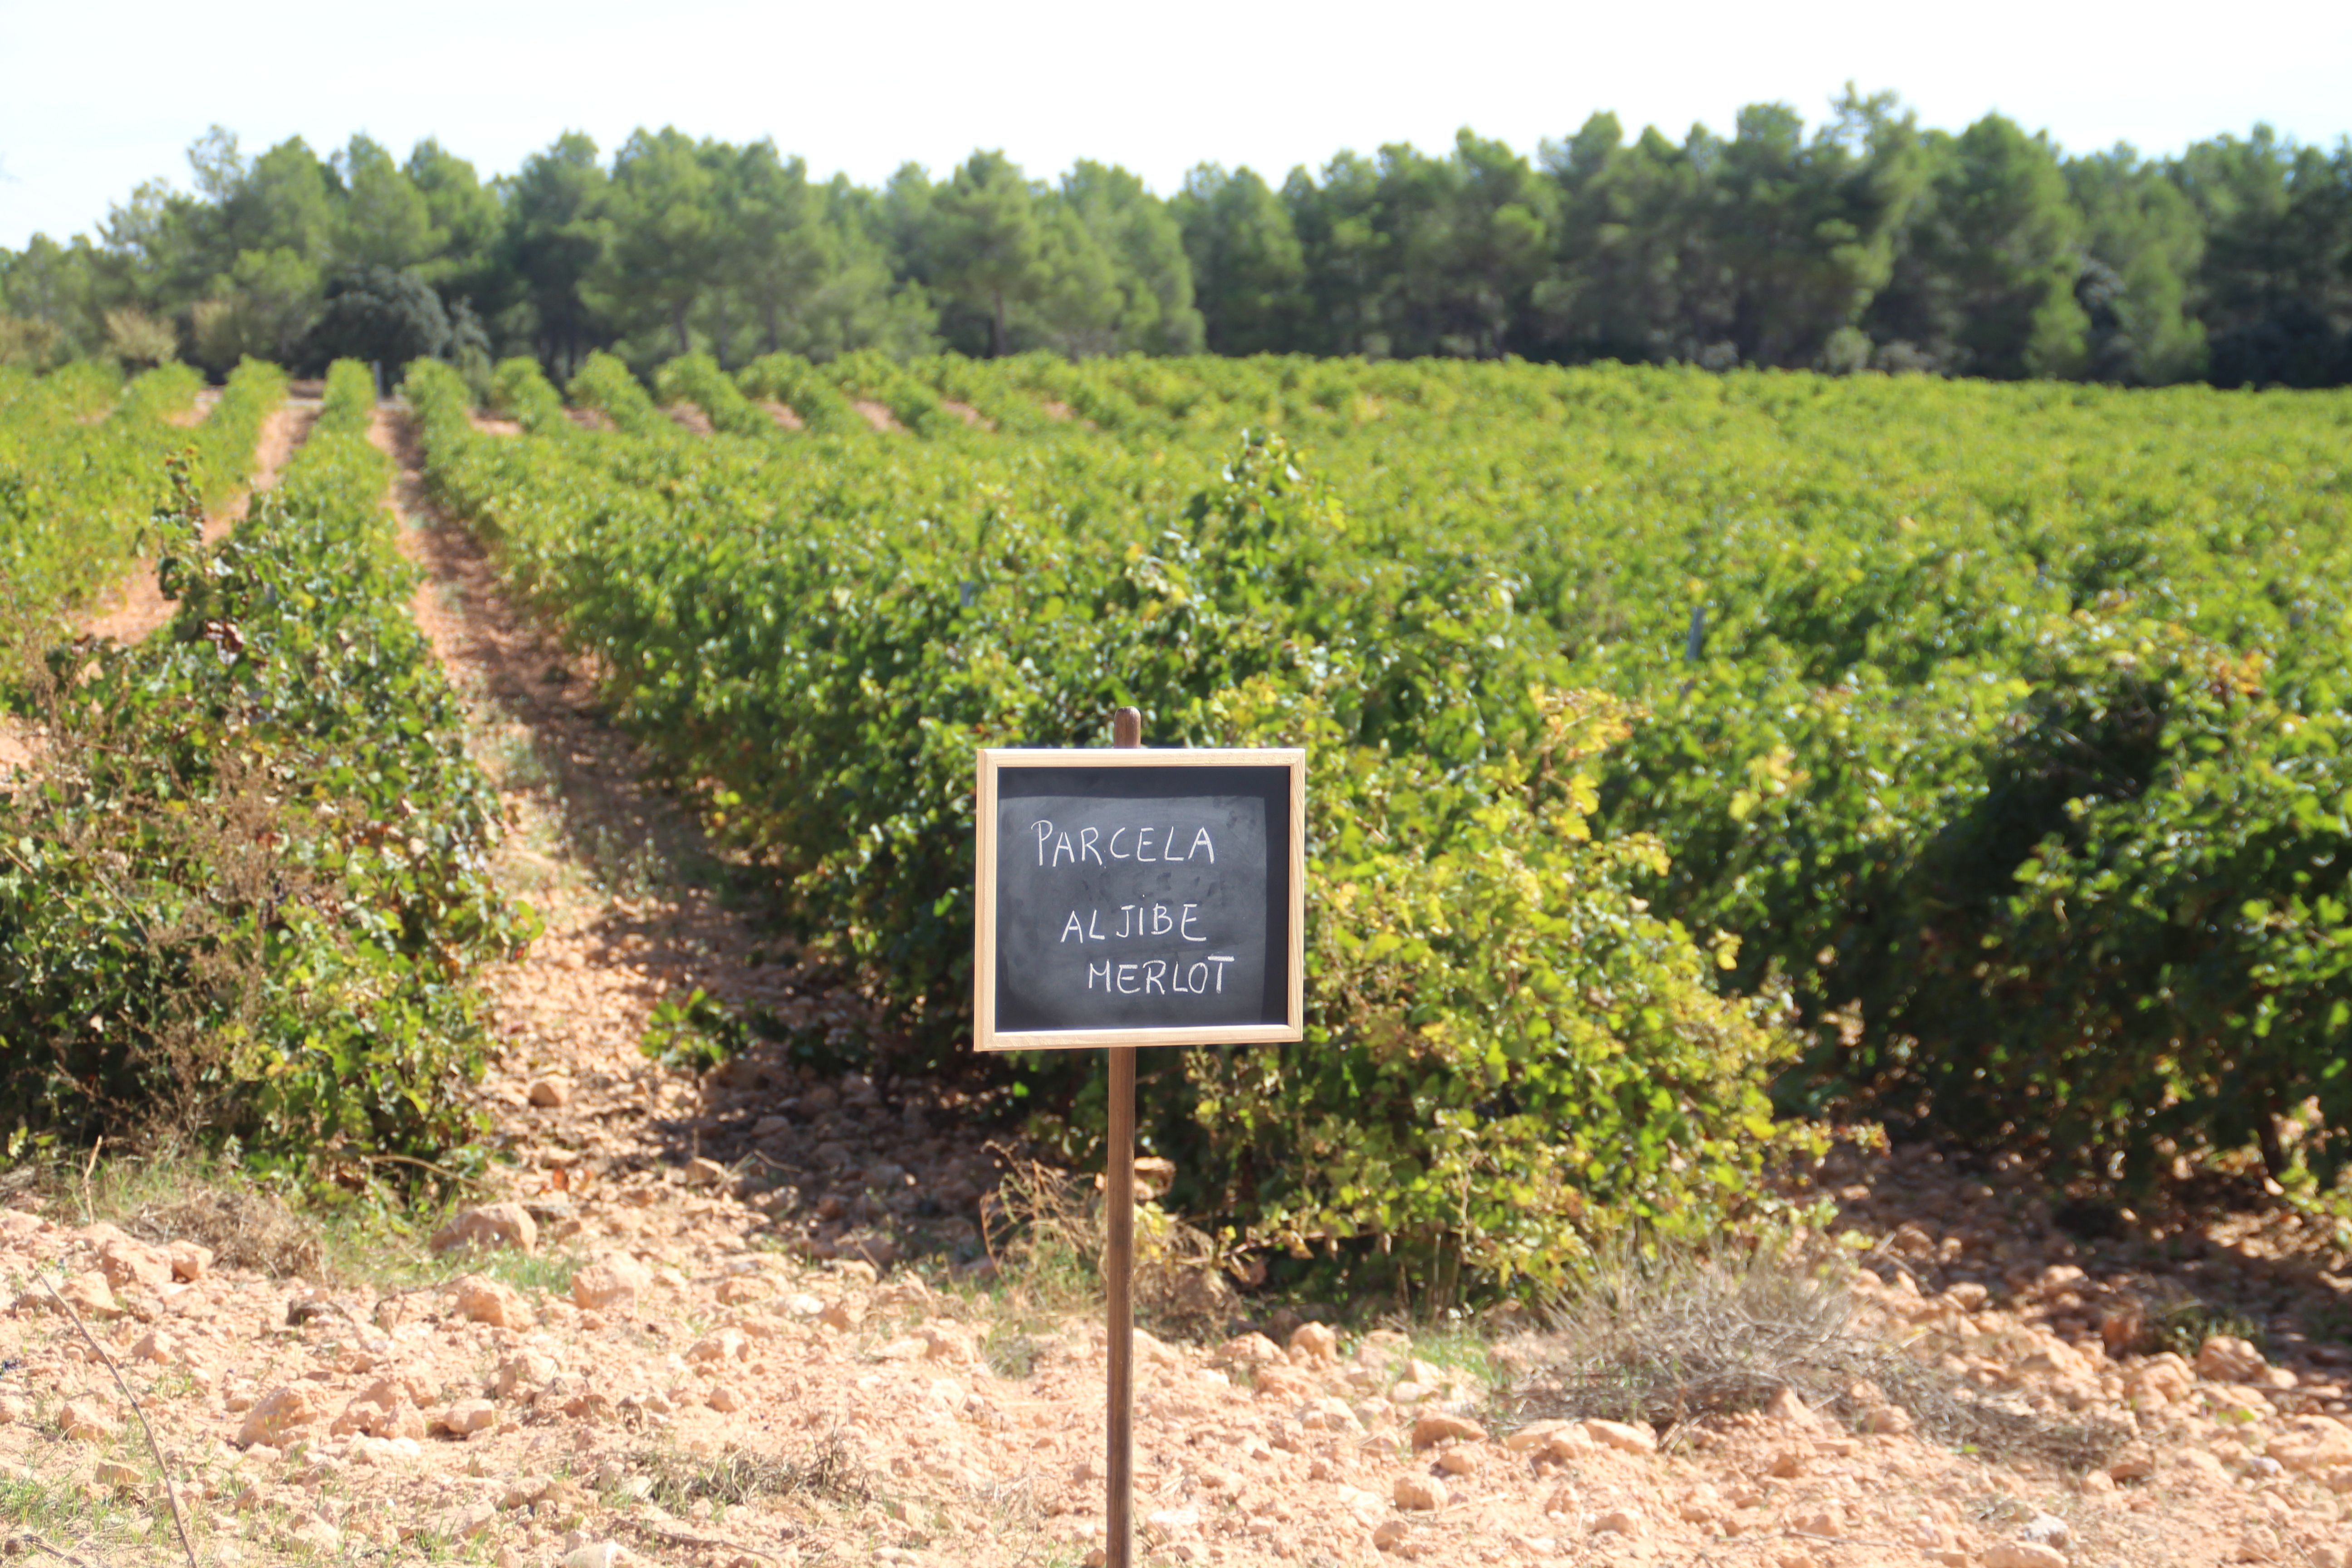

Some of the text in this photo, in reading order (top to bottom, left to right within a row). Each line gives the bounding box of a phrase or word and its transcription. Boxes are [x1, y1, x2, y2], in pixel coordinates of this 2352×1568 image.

[1031, 820, 1215, 867] PARCELA
[1060, 902, 1207, 943] ALJIBE
[1088, 955, 1235, 995] MERLOT
